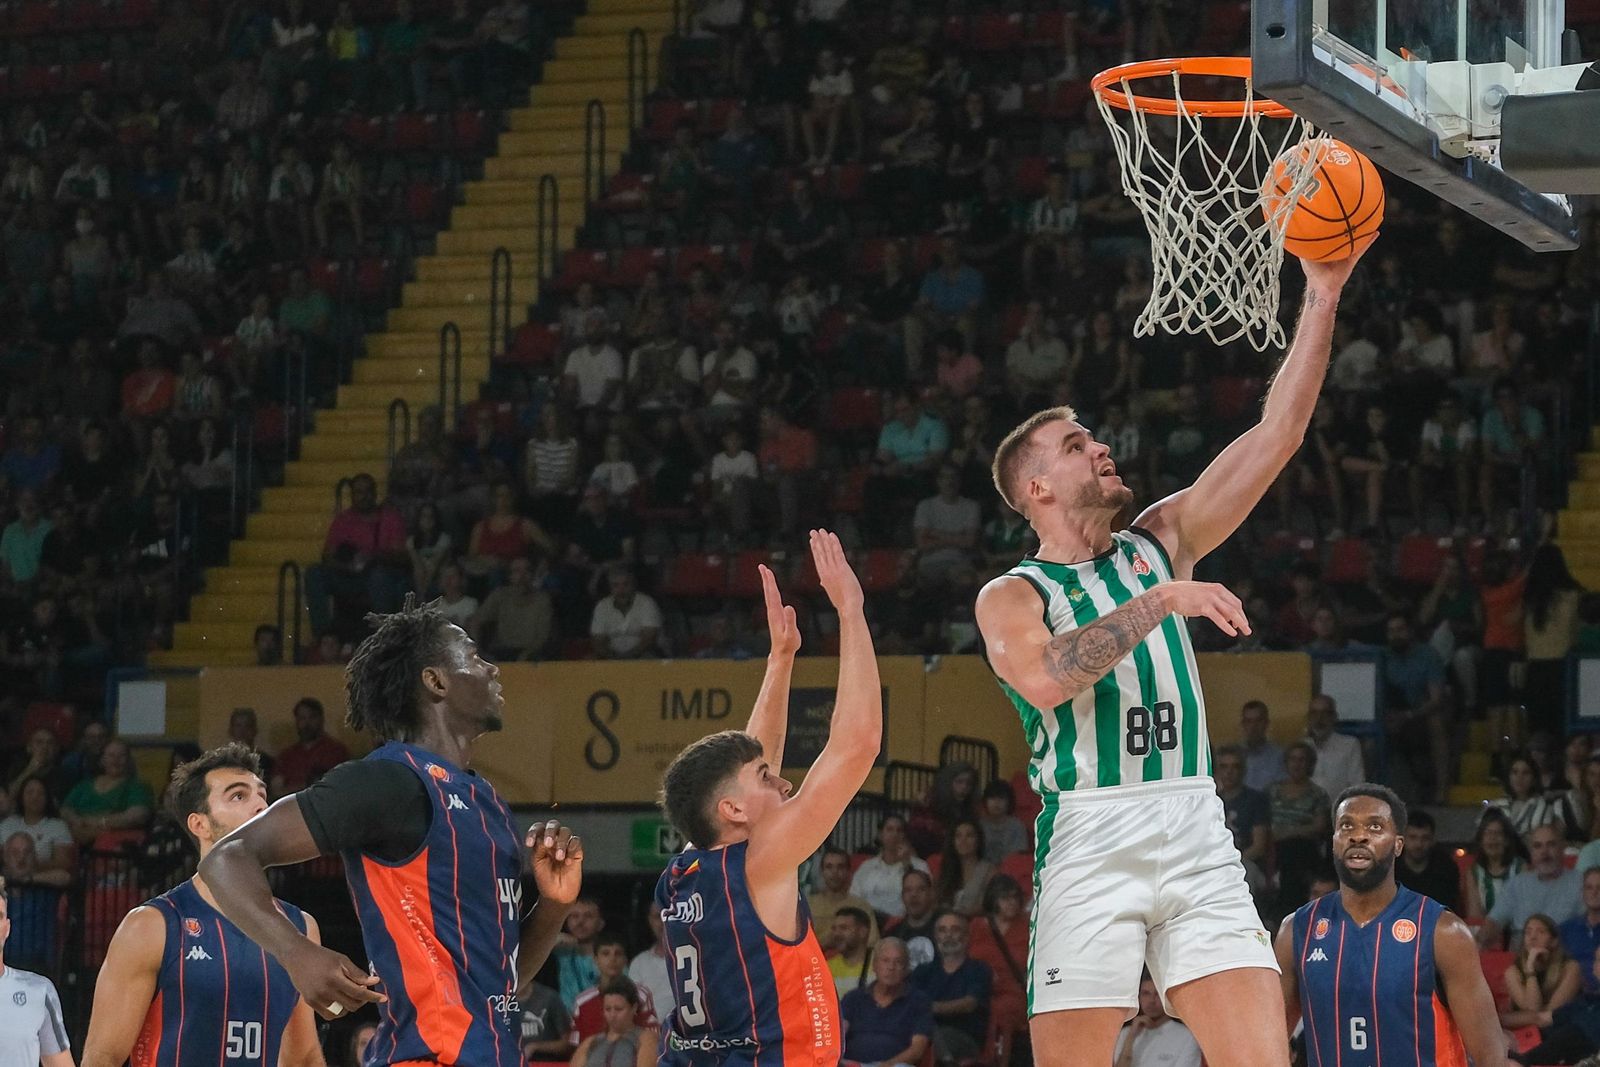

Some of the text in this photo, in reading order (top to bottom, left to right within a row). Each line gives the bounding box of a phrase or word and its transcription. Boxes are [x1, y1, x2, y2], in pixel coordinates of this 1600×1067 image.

[661, 688, 732, 720] IMD
[1126, 701, 1178, 757] 88
[675, 944, 707, 1028] 3
[803, 975, 824, 1047] Burgos 2031
[811, 956, 832, 1046] RENACIMIENTO
[226, 1020, 262, 1059] 50
[1350, 1016, 1367, 1050] 6
